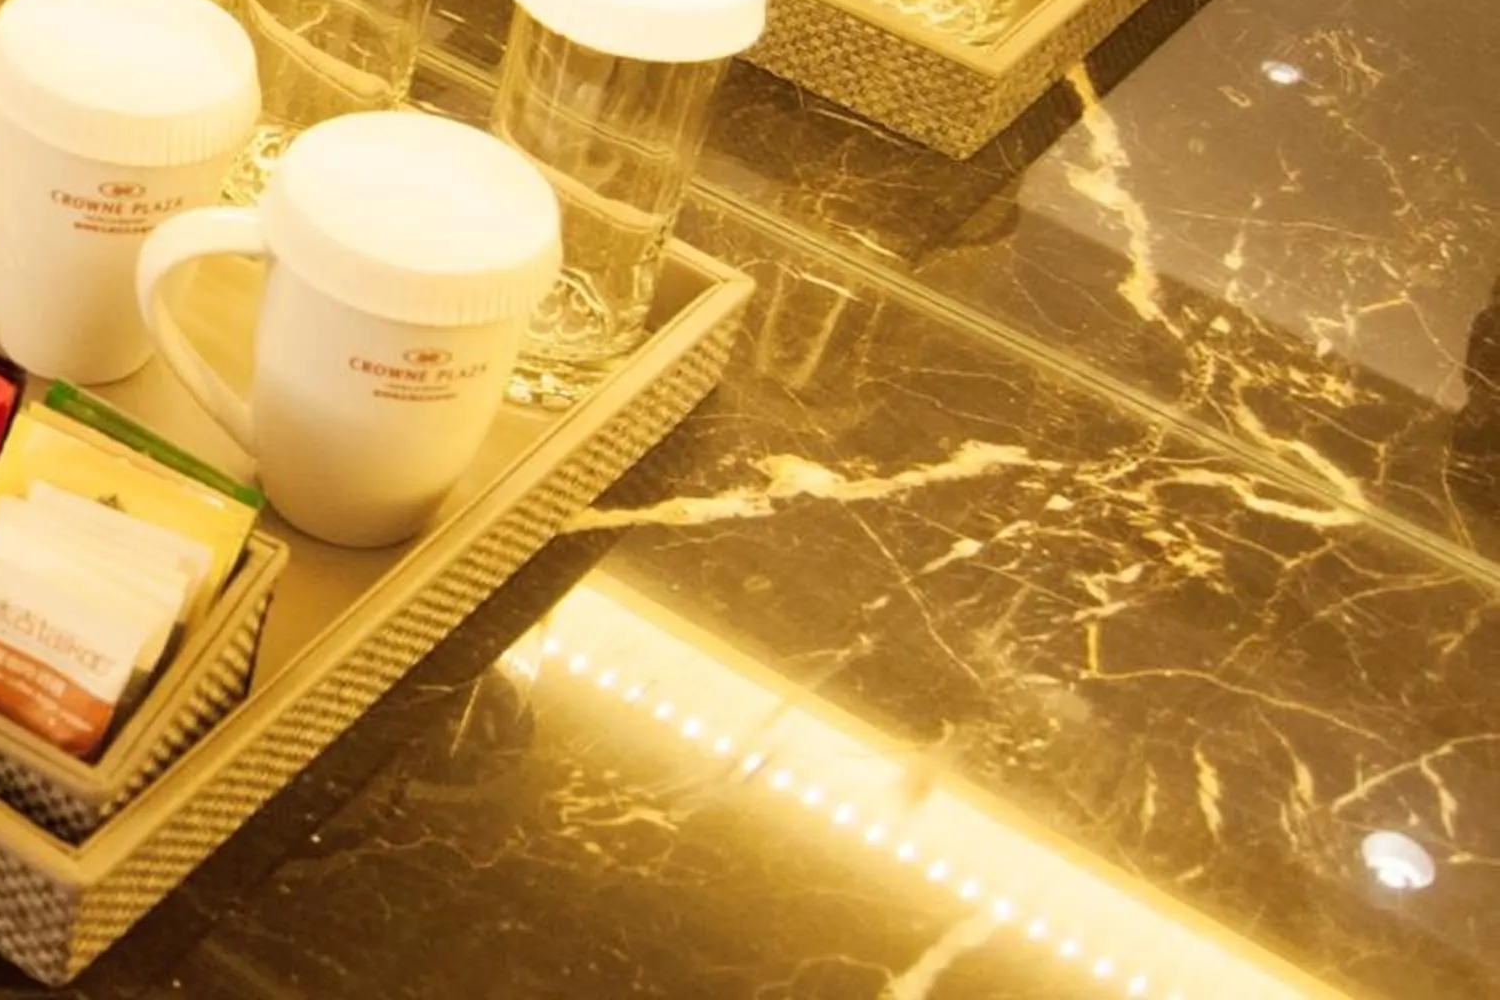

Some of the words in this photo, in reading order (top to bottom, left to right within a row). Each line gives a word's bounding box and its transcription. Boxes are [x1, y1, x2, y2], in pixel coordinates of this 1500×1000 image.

[50, 189, 124, 216] CROWNE
[131, 196, 184, 216] PLAZA
[348, 356, 428, 383] CROWNE
[436, 360, 489, 382] PLAZA
